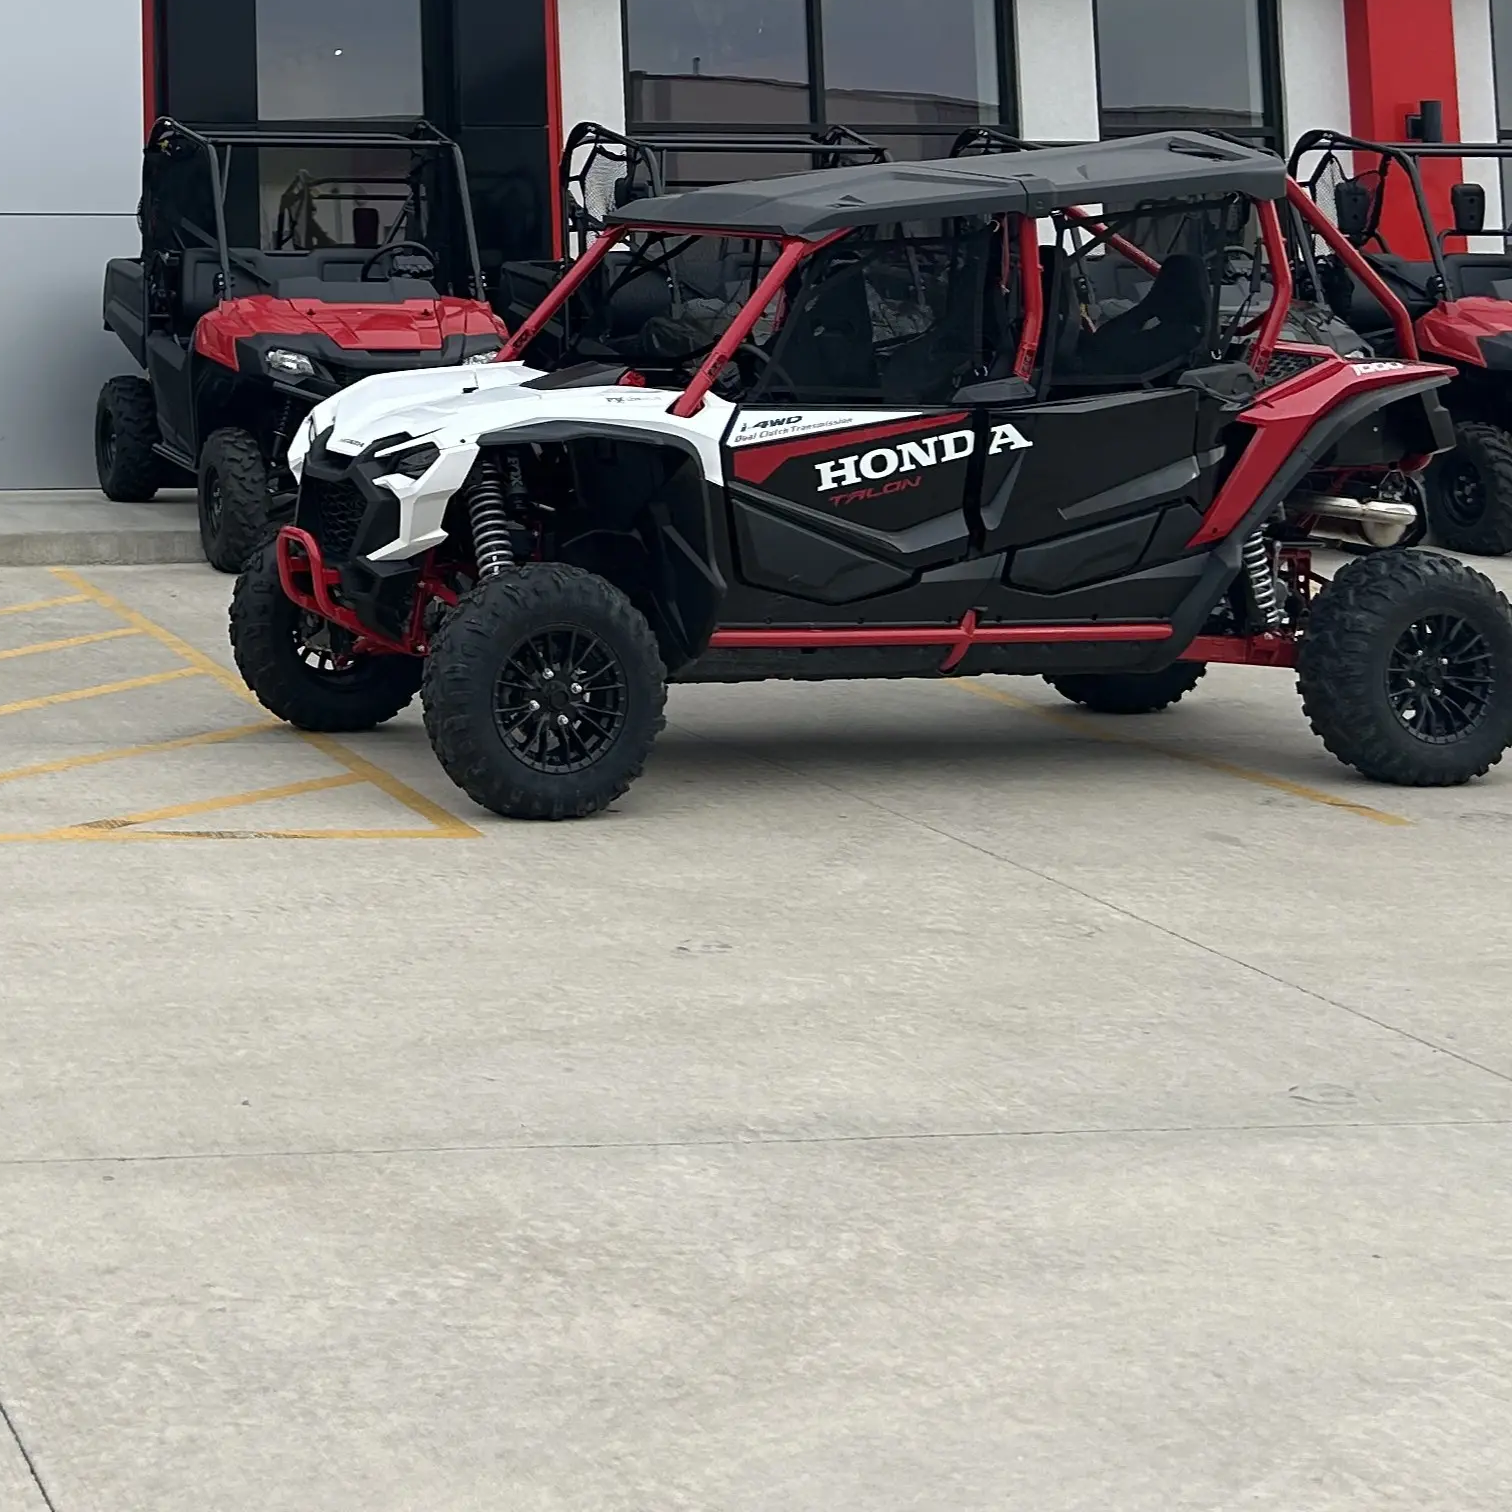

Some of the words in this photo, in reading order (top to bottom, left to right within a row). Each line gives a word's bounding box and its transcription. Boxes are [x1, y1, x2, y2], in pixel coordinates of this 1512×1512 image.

[734, 432, 757, 443] Dual
[759, 426, 789, 438] Clutch
[791, 416, 854, 433] Transmission
[814, 423, 1034, 492] HONDA
[829, 475, 923, 506] TALON
